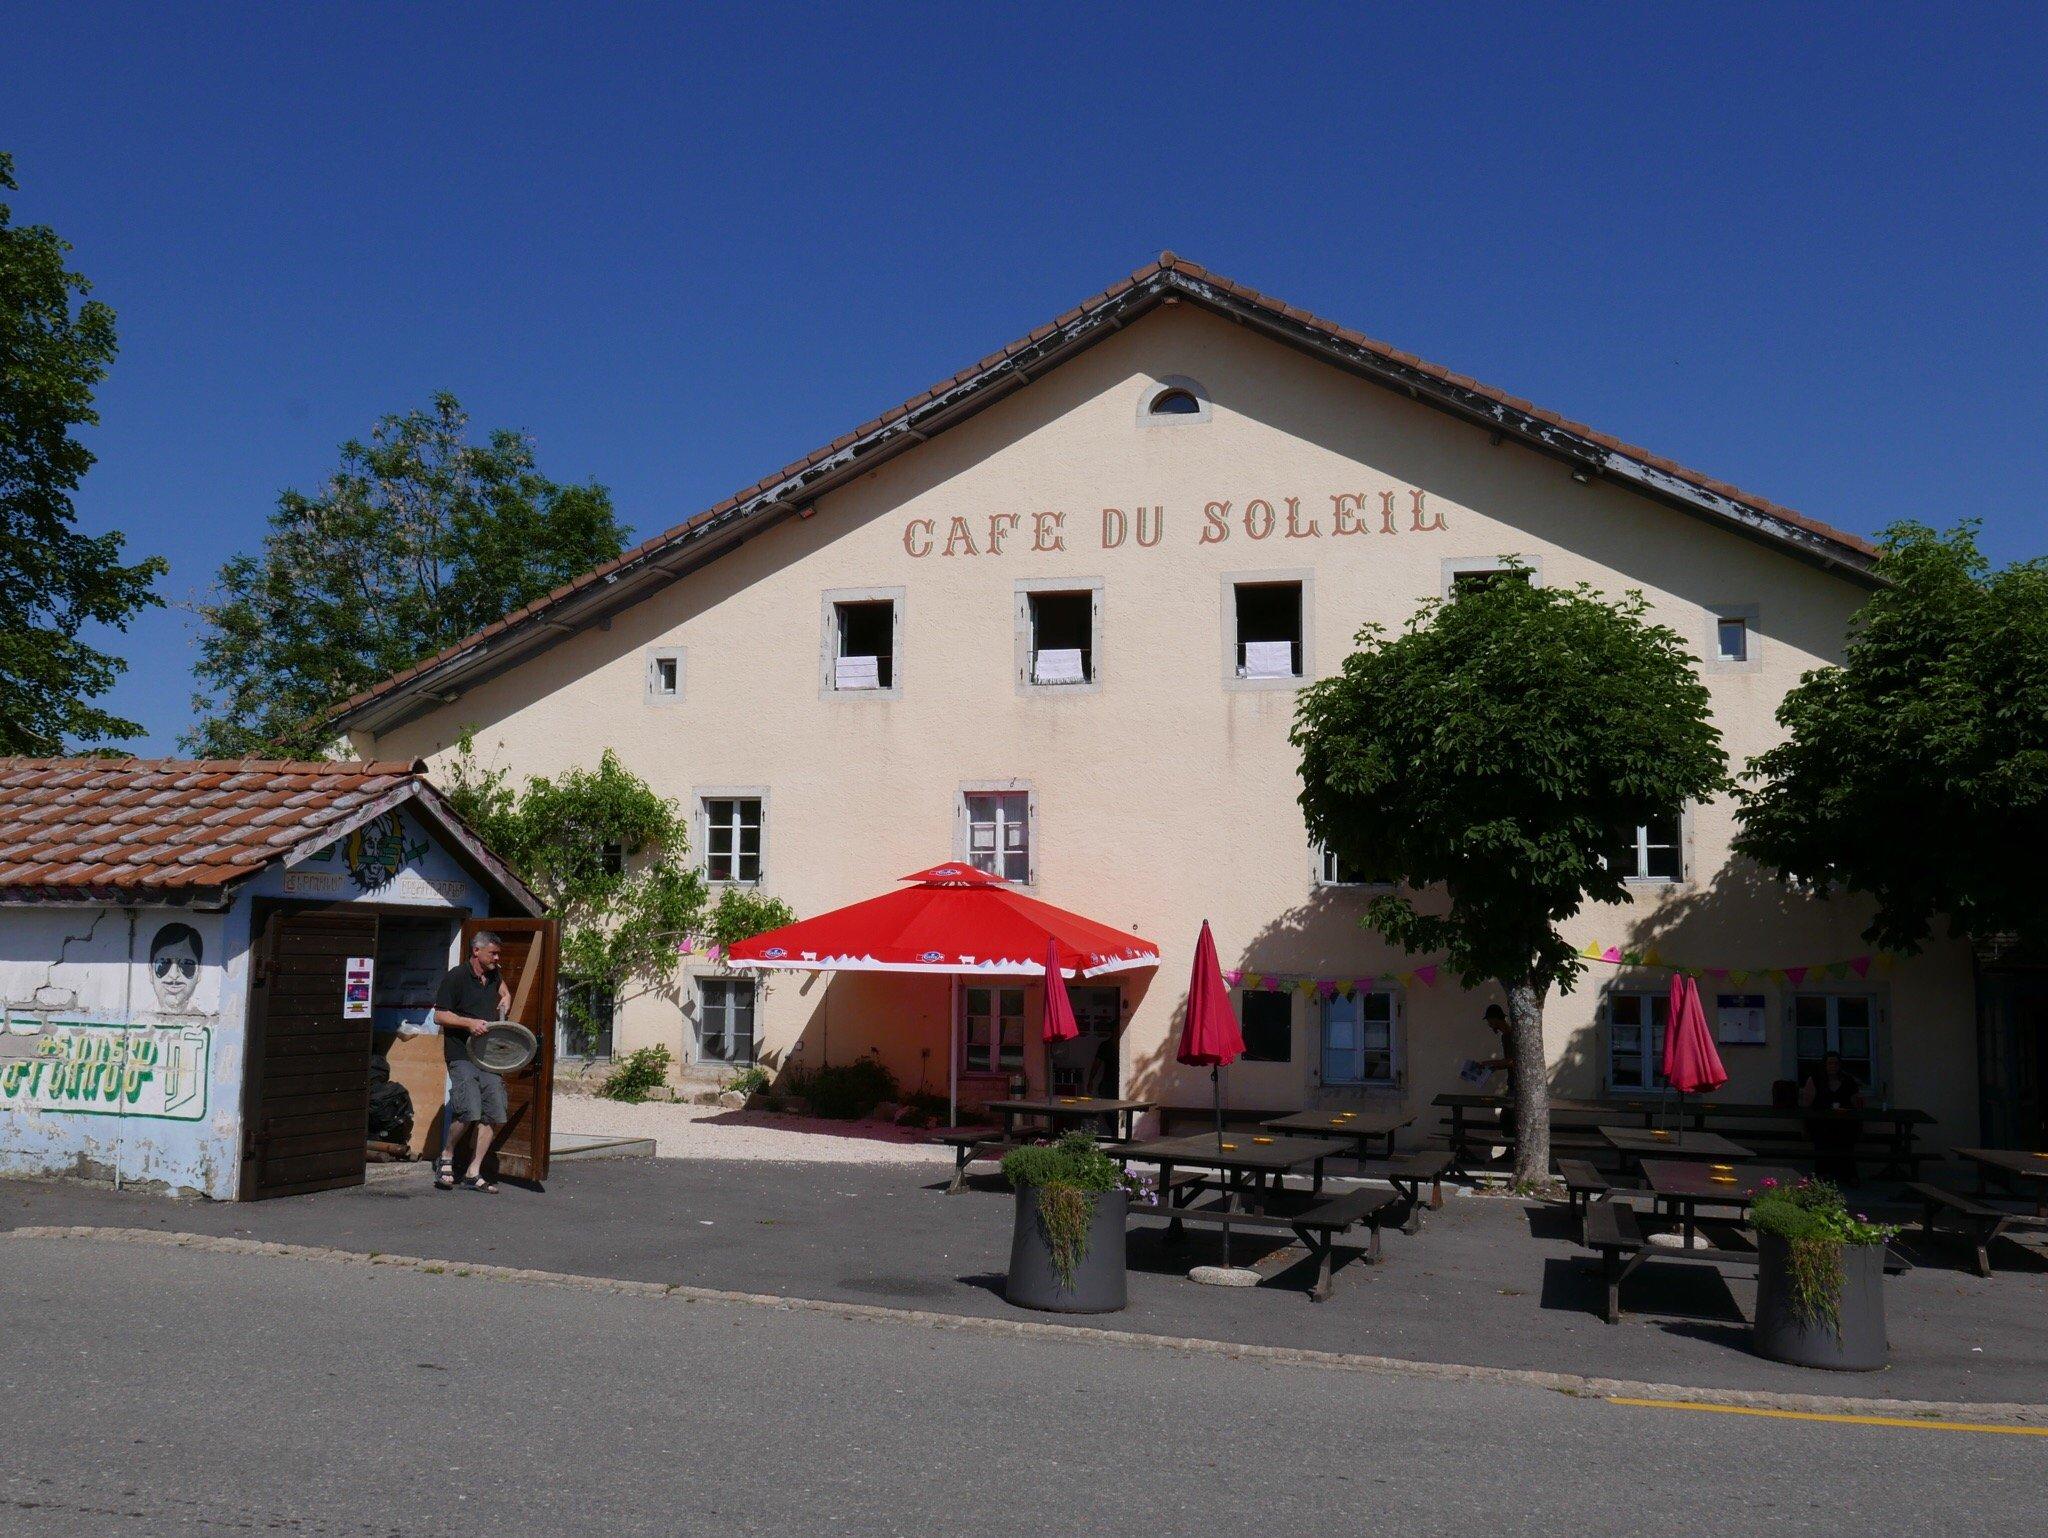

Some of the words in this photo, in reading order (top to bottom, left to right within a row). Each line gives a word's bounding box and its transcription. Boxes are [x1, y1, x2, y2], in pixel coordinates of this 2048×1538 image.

[902, 511, 1067, 558] CAFE
[1102, 506, 1164, 549] DU
[1199, 489, 1450, 546] SOLEIL
